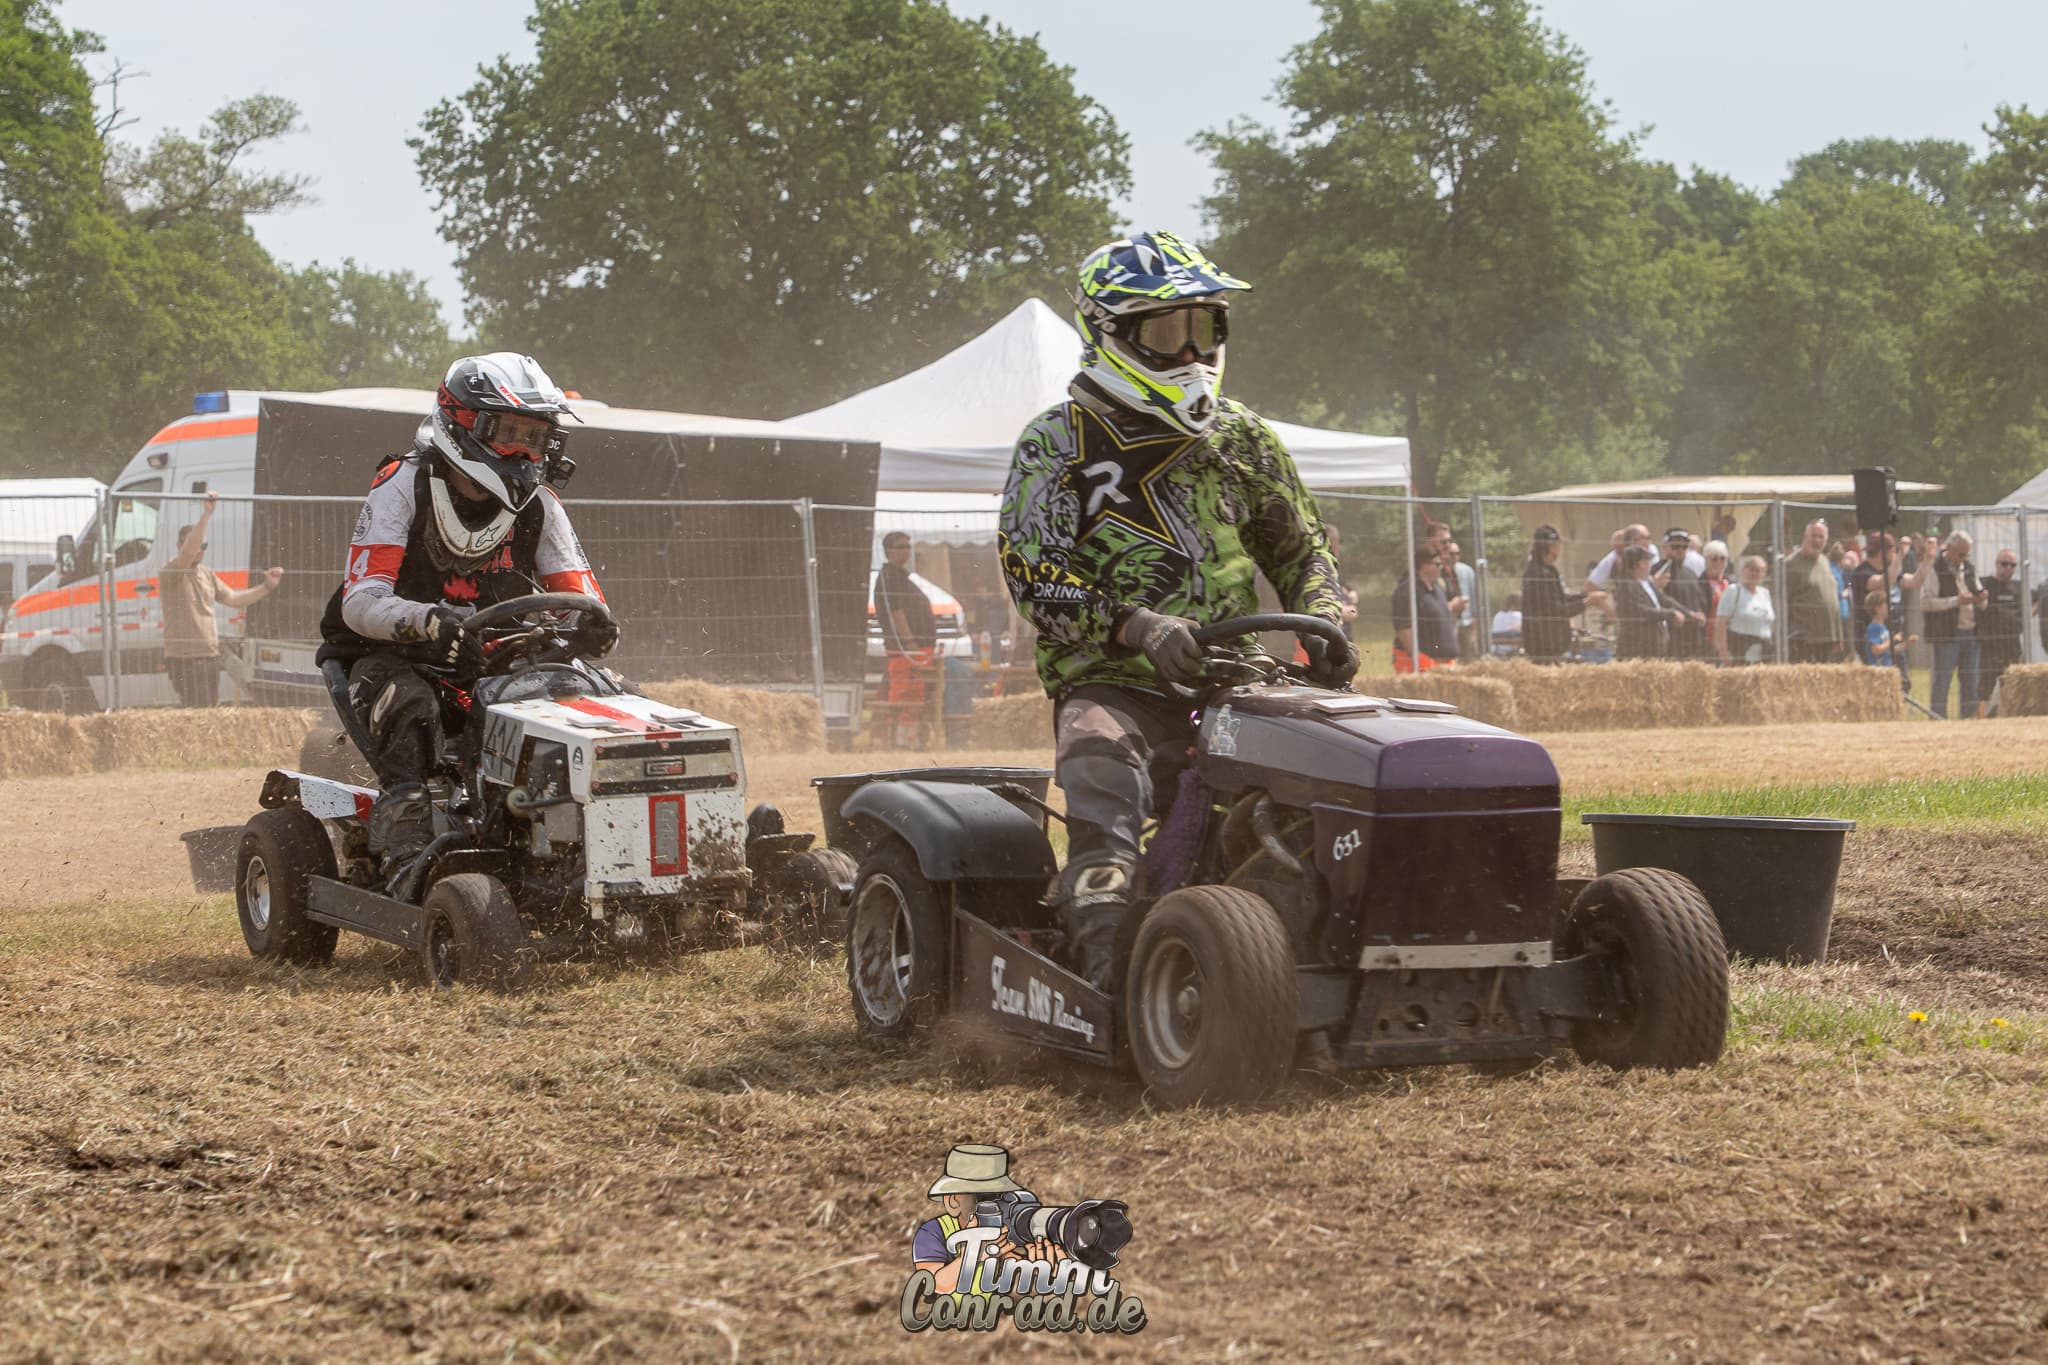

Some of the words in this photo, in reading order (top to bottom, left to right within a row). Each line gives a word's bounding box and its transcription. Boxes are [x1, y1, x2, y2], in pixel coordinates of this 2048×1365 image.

[1081, 460, 1131, 517] R
[1033, 582, 1088, 601] DRINK
[481, 711, 518, 782] 414
